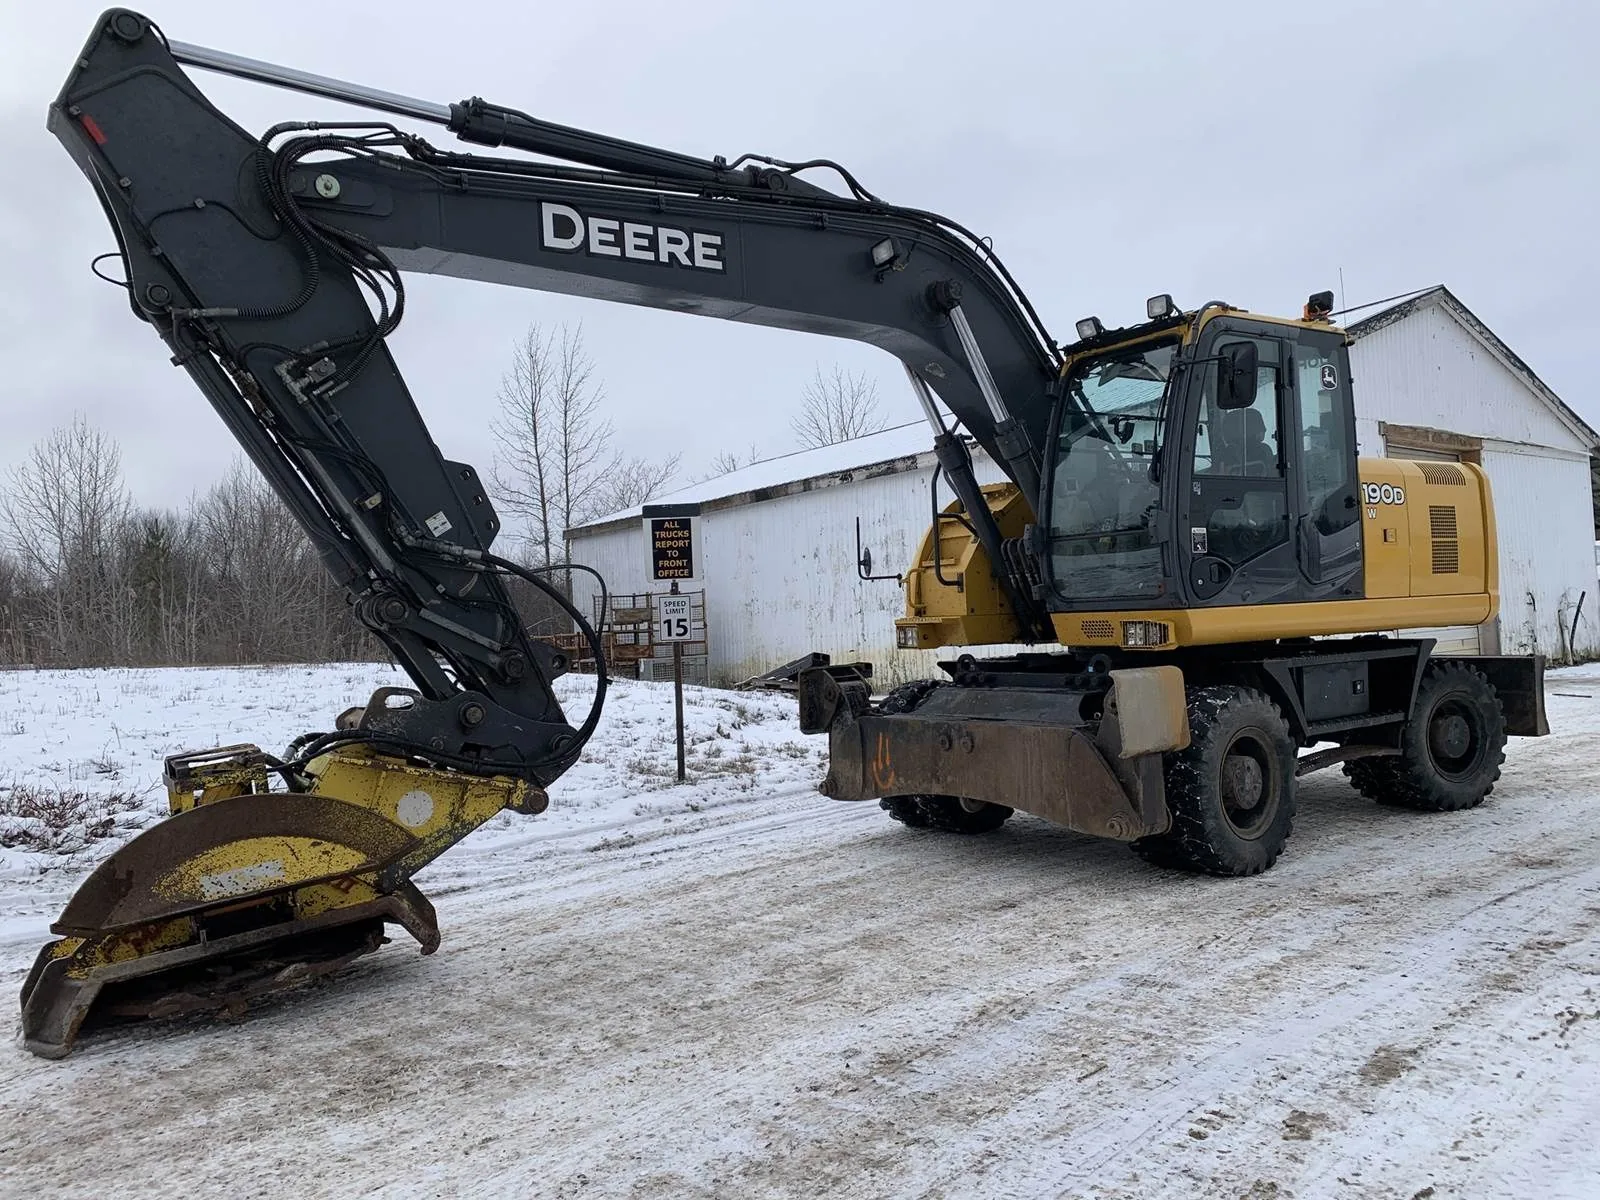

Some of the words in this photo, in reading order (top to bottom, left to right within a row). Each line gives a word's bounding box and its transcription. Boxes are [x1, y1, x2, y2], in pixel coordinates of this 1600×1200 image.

[541, 202, 723, 270] DEERE
[1362, 483, 1405, 505] 190D
[1367, 508, 1377, 519] W
[664, 521, 680, 529] ALL
[655, 530, 690, 539] TRUCKS
[655, 540, 690, 549] REPORT
[667, 550, 679, 558] TO
[659, 560, 688, 568] FRONT
[658, 569, 689, 577] OFFICE
[663, 618, 689, 637] 15
